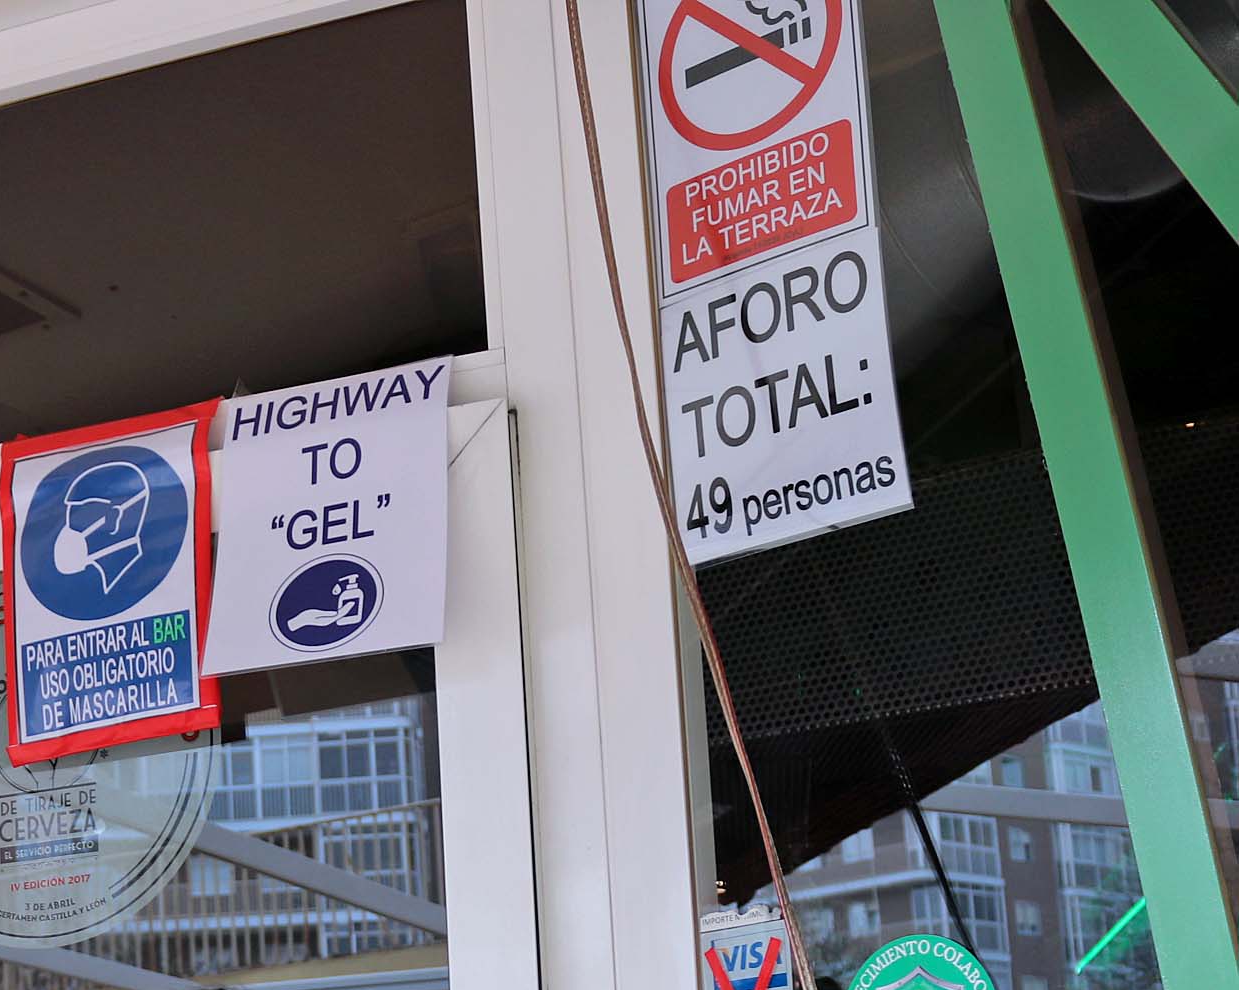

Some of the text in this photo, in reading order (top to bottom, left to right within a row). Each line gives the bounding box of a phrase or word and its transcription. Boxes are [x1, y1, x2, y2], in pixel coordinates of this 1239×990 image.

[685, 132, 829, 206] PROHIBIDO
[692, 162, 826, 232] FUMAR EN
[682, 236, 713, 265] LA
[718, 187, 843, 250] TERRAZA
[673, 250, 867, 373] AFORO
[231, 365, 445, 440] HIGHWAY
[681, 354, 872, 458] TOTAL:
[302, 438, 362, 485] TO
[687, 455, 896, 538] 49 personas
[26, 614, 186, 672] PARA ENTRAR AL BAR
[39, 647, 174, 699] USO OBLIGATORIO
[42, 679, 178, 731] DE MASCARILLA
[0, 808, 96, 842] CERVEZA
[1, 789, 96, 816] DE TIRAJE DE
[4, 848, 14, 860] EL
[16, 845, 52, 859] SERVICIO
[10, 883, 20, 892] IV
[68, 873, 91, 884] 2017
[25, 898, 76, 911] 3 DE ABRIL
[39, 909, 78, 921] CASTILLA
[702, 914, 734, 926] IMPORTE
[722, 940, 781, 971] VIS
